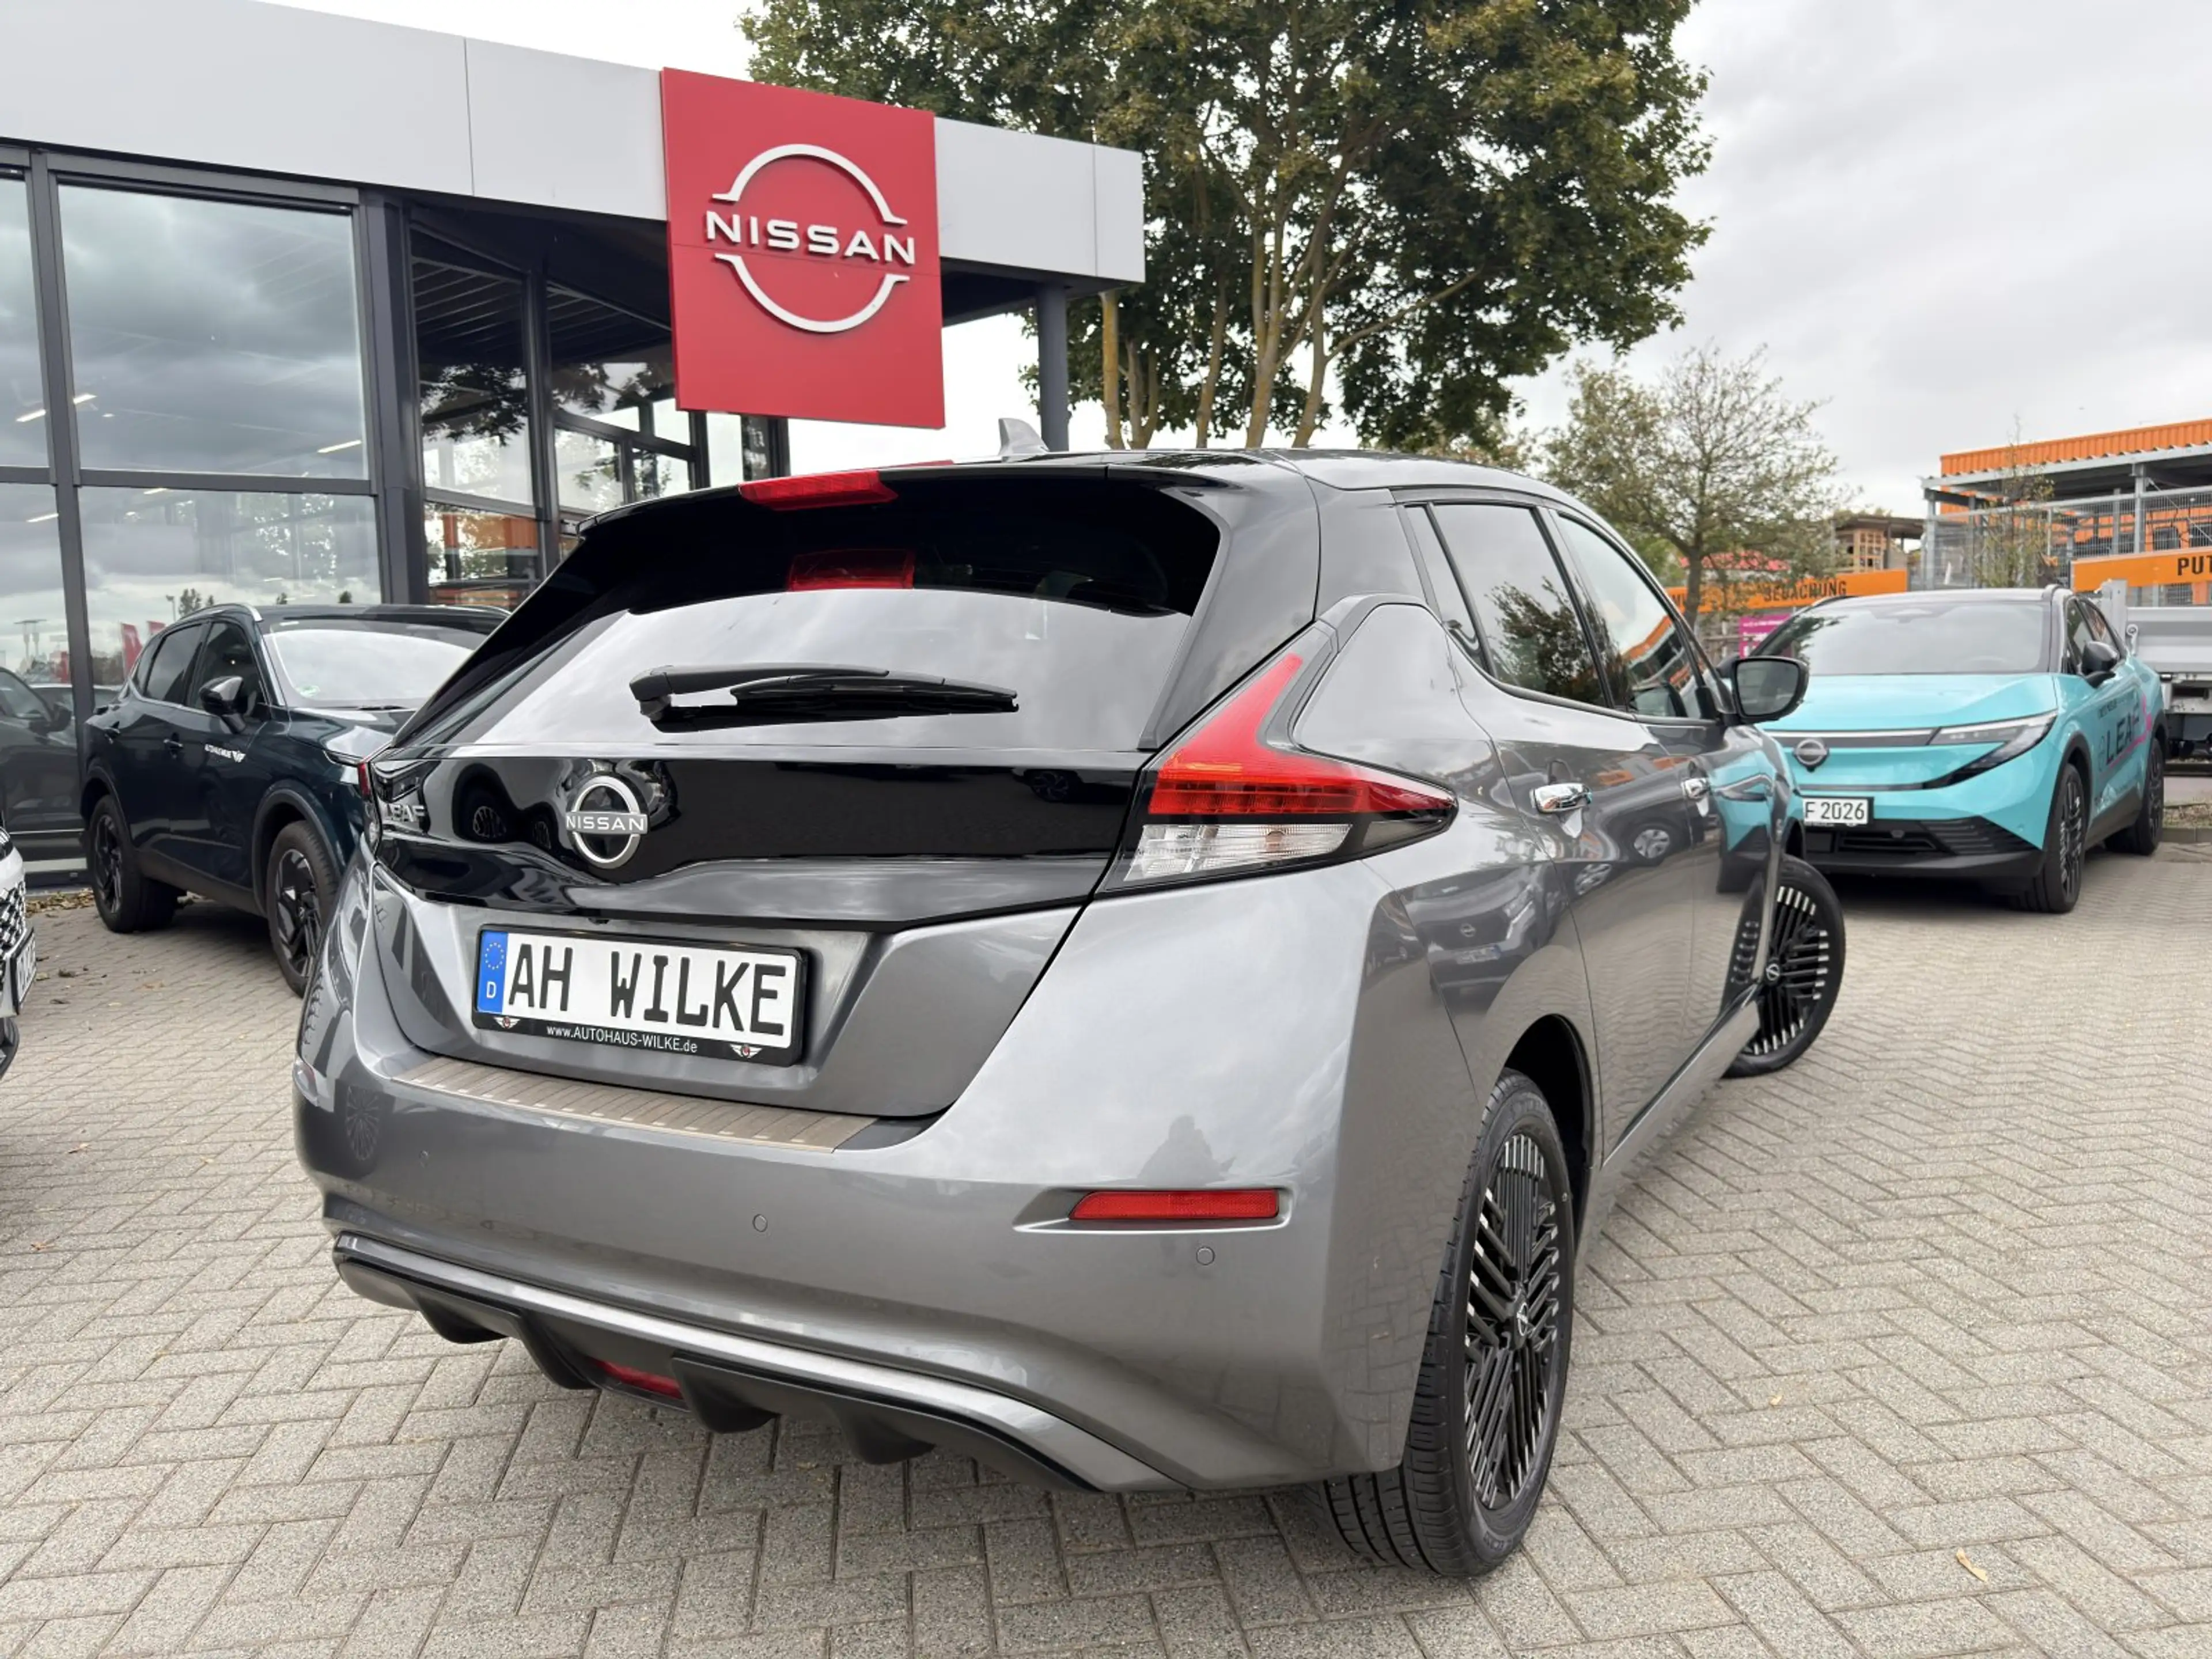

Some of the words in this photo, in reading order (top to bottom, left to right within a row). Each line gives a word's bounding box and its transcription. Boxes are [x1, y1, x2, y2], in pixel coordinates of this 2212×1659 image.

[706, 210, 915, 265] NISSAN
[383, 804, 425, 822] LEAF
[1821, 801, 1865, 820] 2026
[566, 815, 644, 831] NISSAN
[486, 980, 497, 999] D
[507, 942, 574, 1012] AH
[610, 950, 787, 1036] WILKE
[546, 1025, 698, 1054] www.AUTOHAUS-WILKE.de
